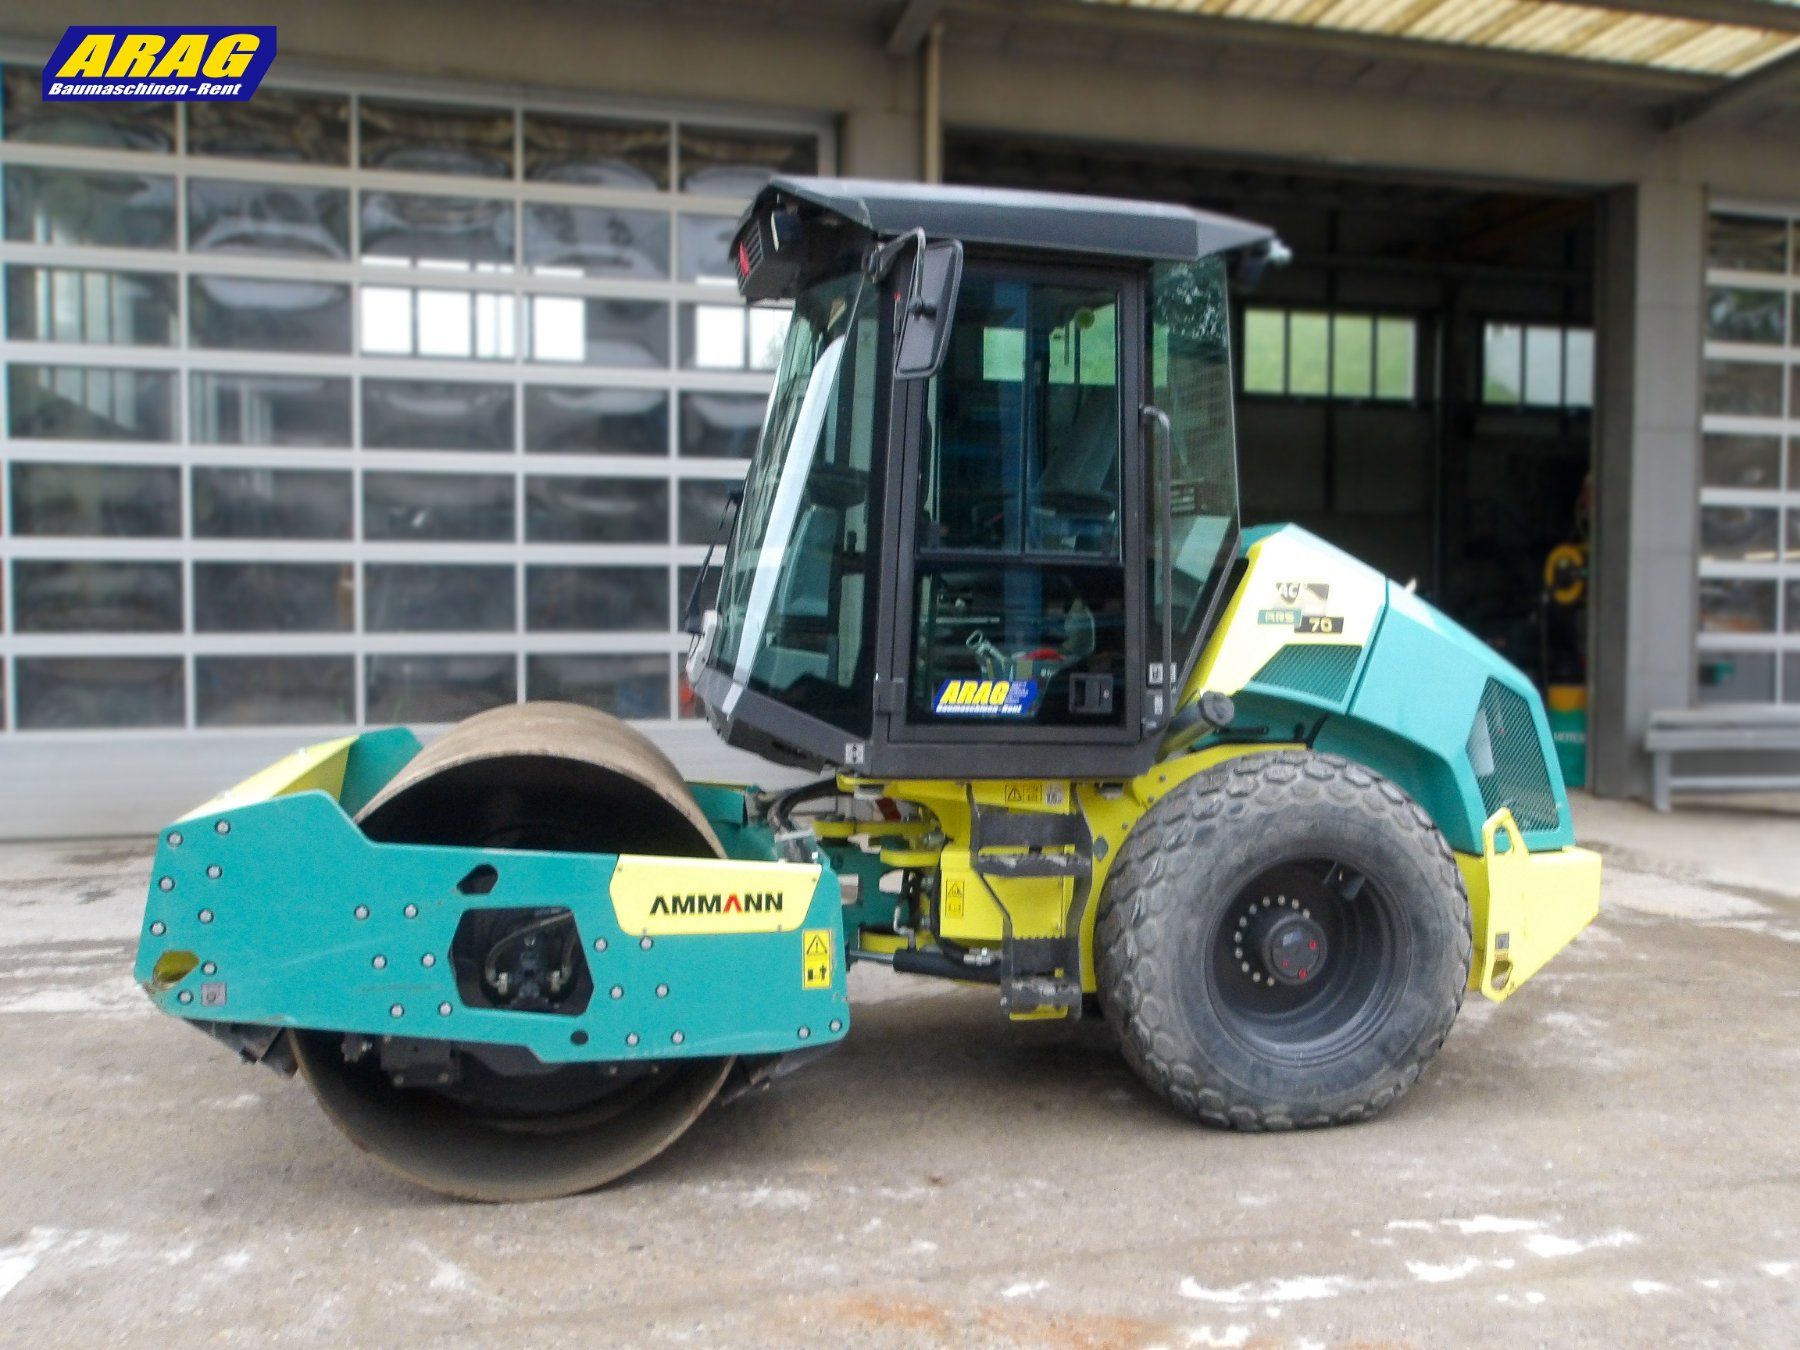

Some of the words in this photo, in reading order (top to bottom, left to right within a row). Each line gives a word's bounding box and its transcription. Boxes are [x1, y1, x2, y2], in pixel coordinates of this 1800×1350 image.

[1308, 617, 1333, 633] 70
[939, 680, 1010, 705] ARAG
[649, 892, 784, 915] AMMANN
